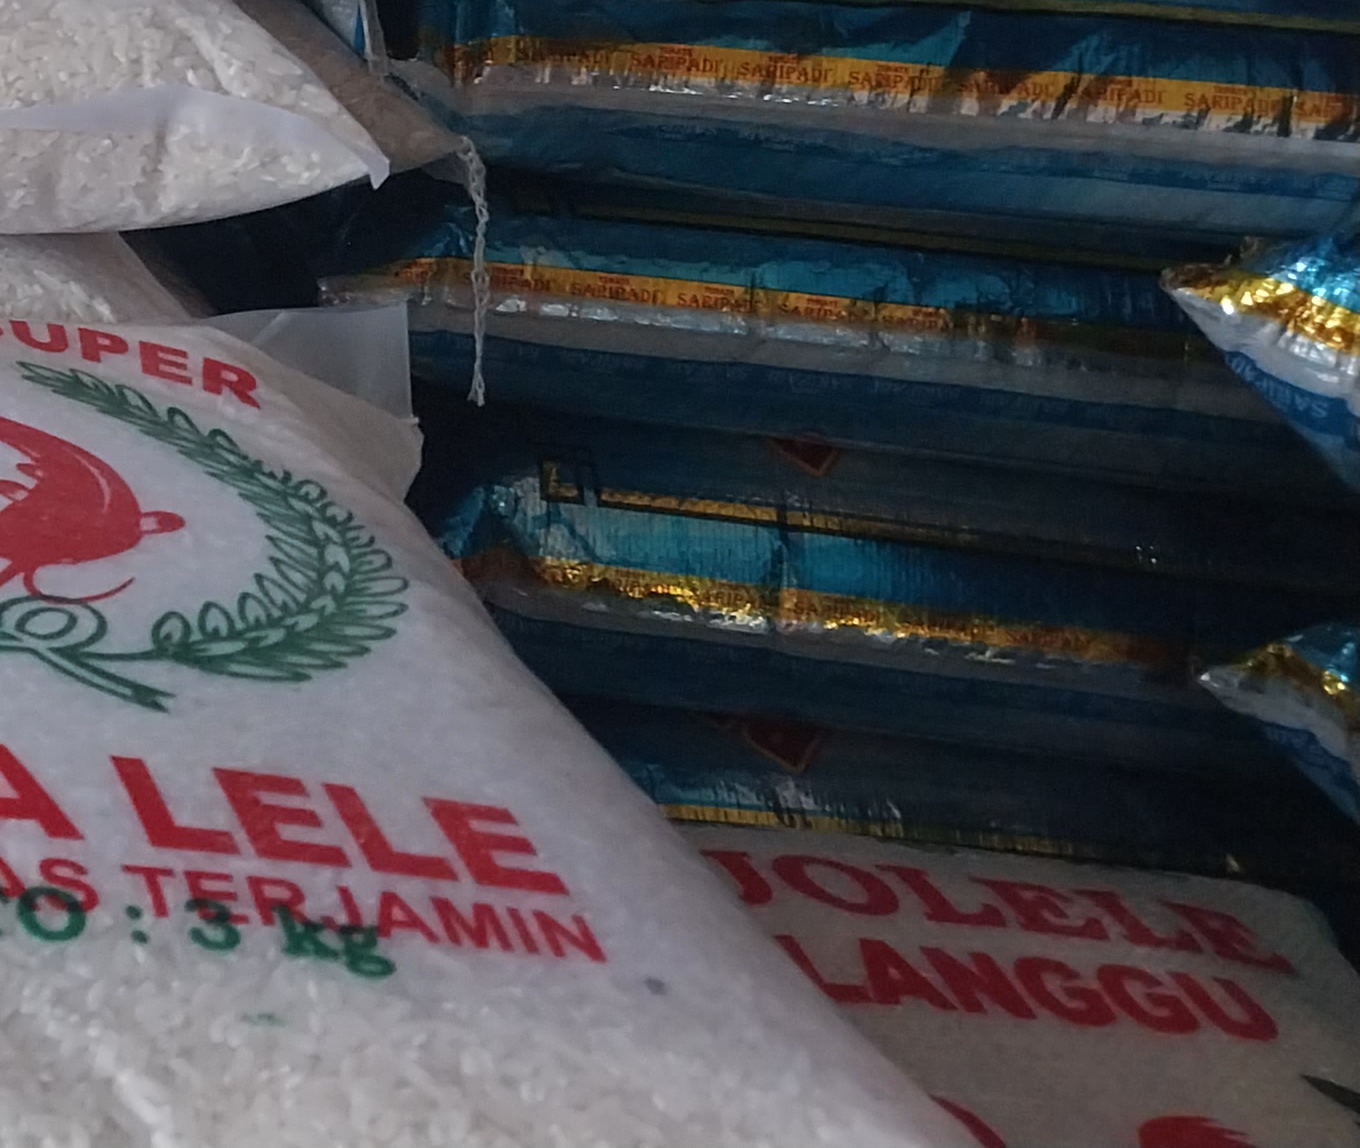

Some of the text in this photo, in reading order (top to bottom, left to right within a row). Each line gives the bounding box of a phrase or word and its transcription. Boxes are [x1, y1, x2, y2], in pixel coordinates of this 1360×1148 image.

[630, 52, 722, 74] SARIPADI
[740, 61, 834, 84] SARIPADI
[571, 282, 664, 305] SARIPADI
[109, 754, 568, 896] LELE
[121, 863, 608, 964] TERJAMIN
[279, 905, 398, 980] kg
[772, 935, 1279, 1043] LANGGU
